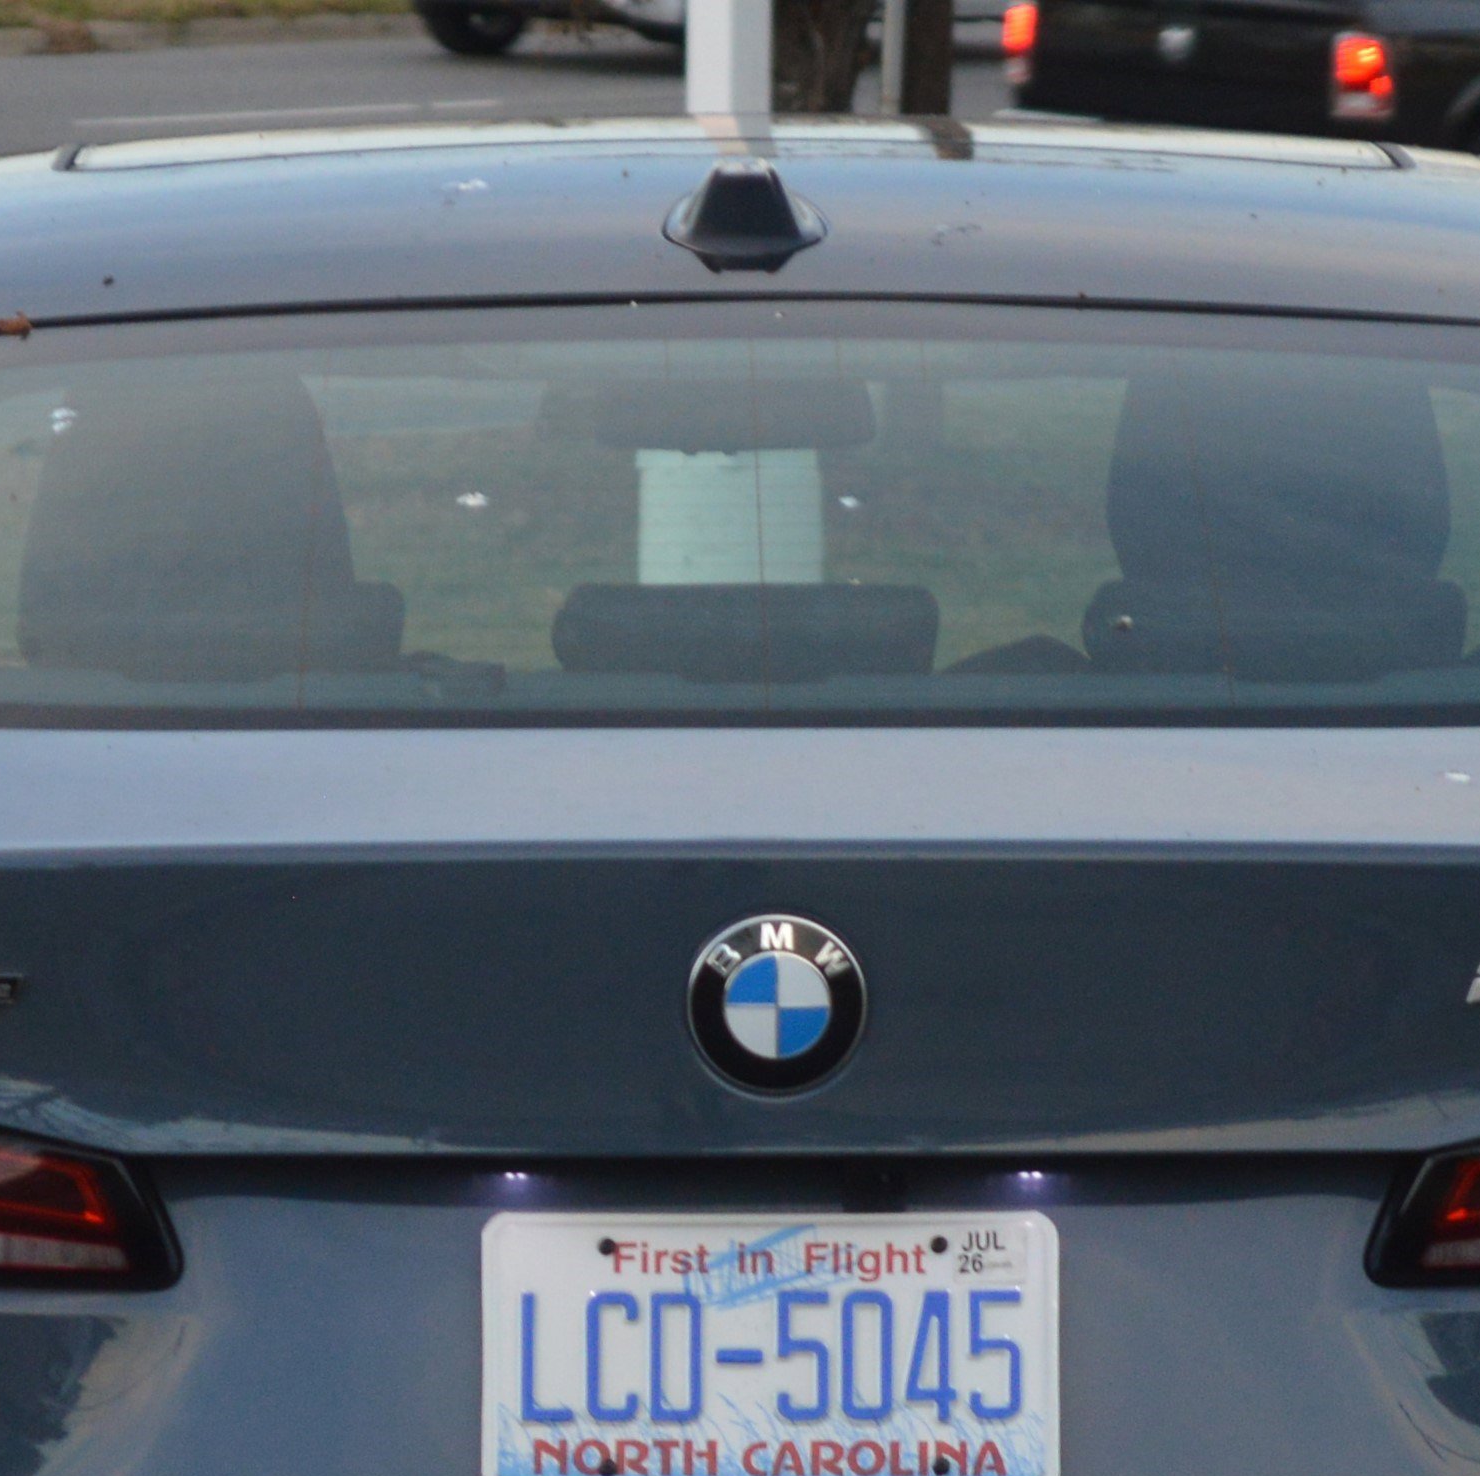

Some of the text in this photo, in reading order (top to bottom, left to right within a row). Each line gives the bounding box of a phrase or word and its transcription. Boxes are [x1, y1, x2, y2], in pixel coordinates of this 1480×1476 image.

[706, 922, 851, 977] BMW
[961, 1231, 1006, 1252] JUL
[611, 1242, 928, 1283] First in Flight
[959, 1253, 983, 1273] 26
[520, 1290, 1022, 1423] LCD-5045
[532, 1439, 1007, 1476] NORTH CAROLINA
